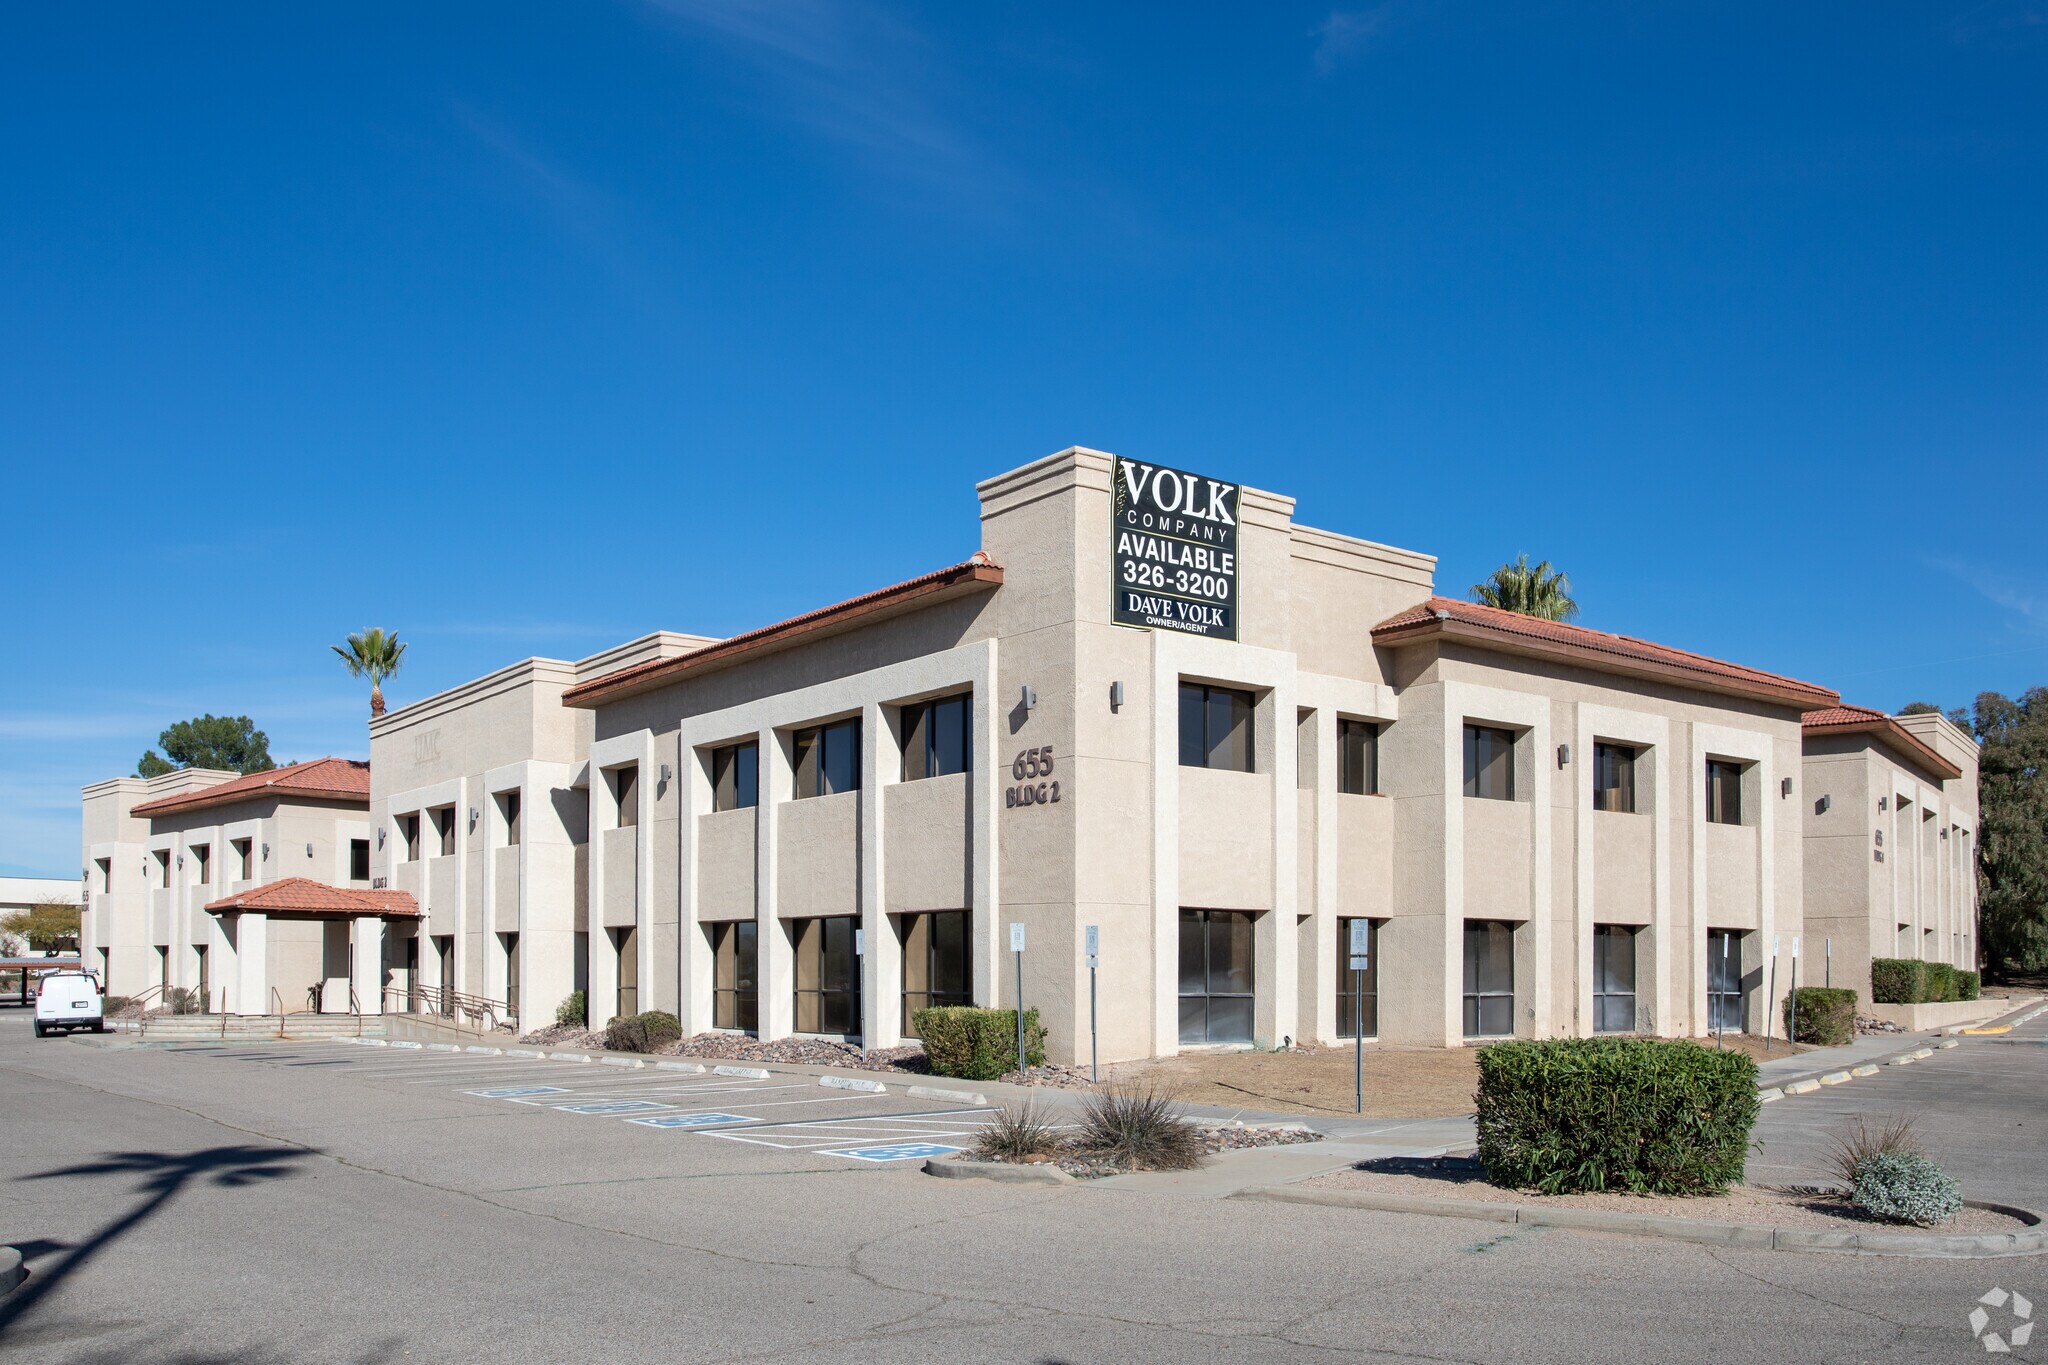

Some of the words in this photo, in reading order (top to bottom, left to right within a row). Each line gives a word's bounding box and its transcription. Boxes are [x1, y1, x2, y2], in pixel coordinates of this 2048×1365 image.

[1120, 460, 1236, 526] VOLK
[1127, 509, 1227, 543] COMPANY
[1117, 532, 1234, 576] AVAILABLE
[1123, 560, 1228, 600] 326-3200
[1128, 593, 1173, 618] DAVE
[1176, 602, 1224, 627] VOLK
[1146, 616, 1208, 634] OWNER/AGENT
[1012, 745, 1054, 781] 655
[1006, 782, 1047, 808] BLDG
[1050, 780, 1061, 804] 2
